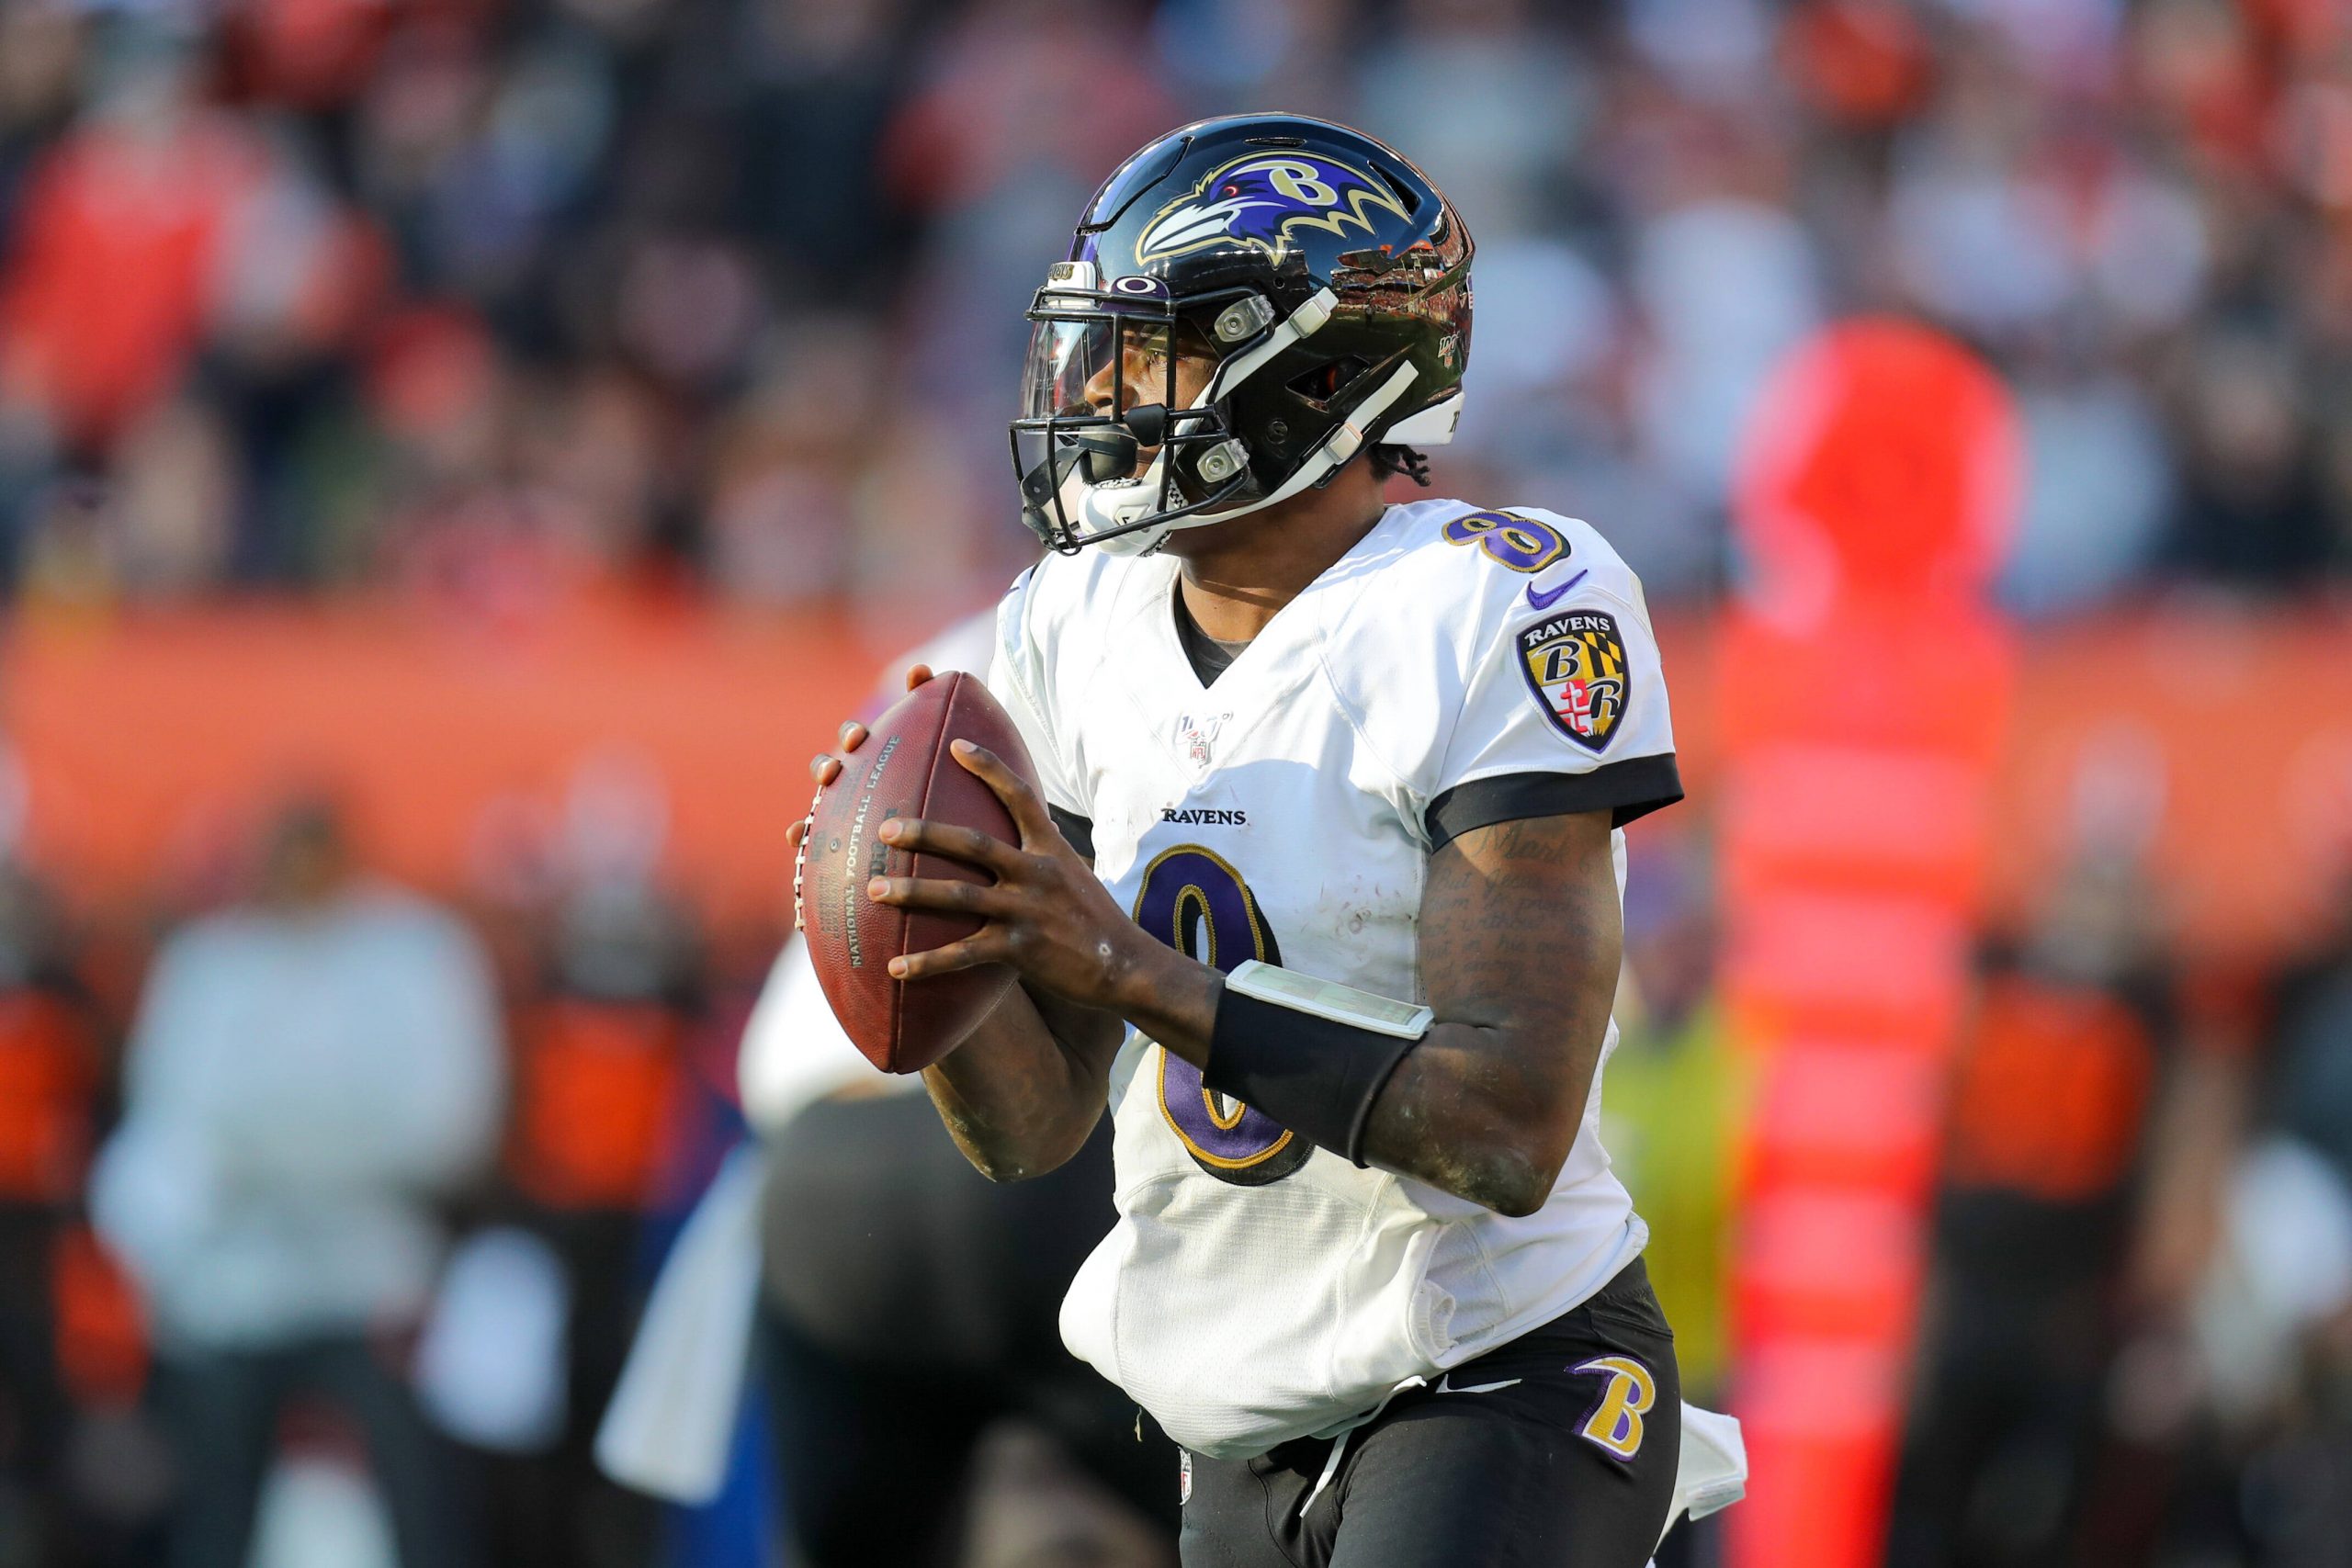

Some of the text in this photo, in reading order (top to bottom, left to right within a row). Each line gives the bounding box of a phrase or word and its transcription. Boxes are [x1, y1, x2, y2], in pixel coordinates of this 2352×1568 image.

[1262, 159, 1339, 207] B
[1442, 509, 1572, 574] 8
[1523, 615, 1611, 648] RAVENS
[1530, 639, 1581, 682] B
[1586, 679, 1623, 720] R
[866, 735, 900, 790] LEAGUE
[845, 795, 871, 879] FOOTBALL
[1161, 807, 1247, 827] RAVENS
[845, 884, 864, 968] NATIONAL
[1565, 1353, 1657, 1462] B
